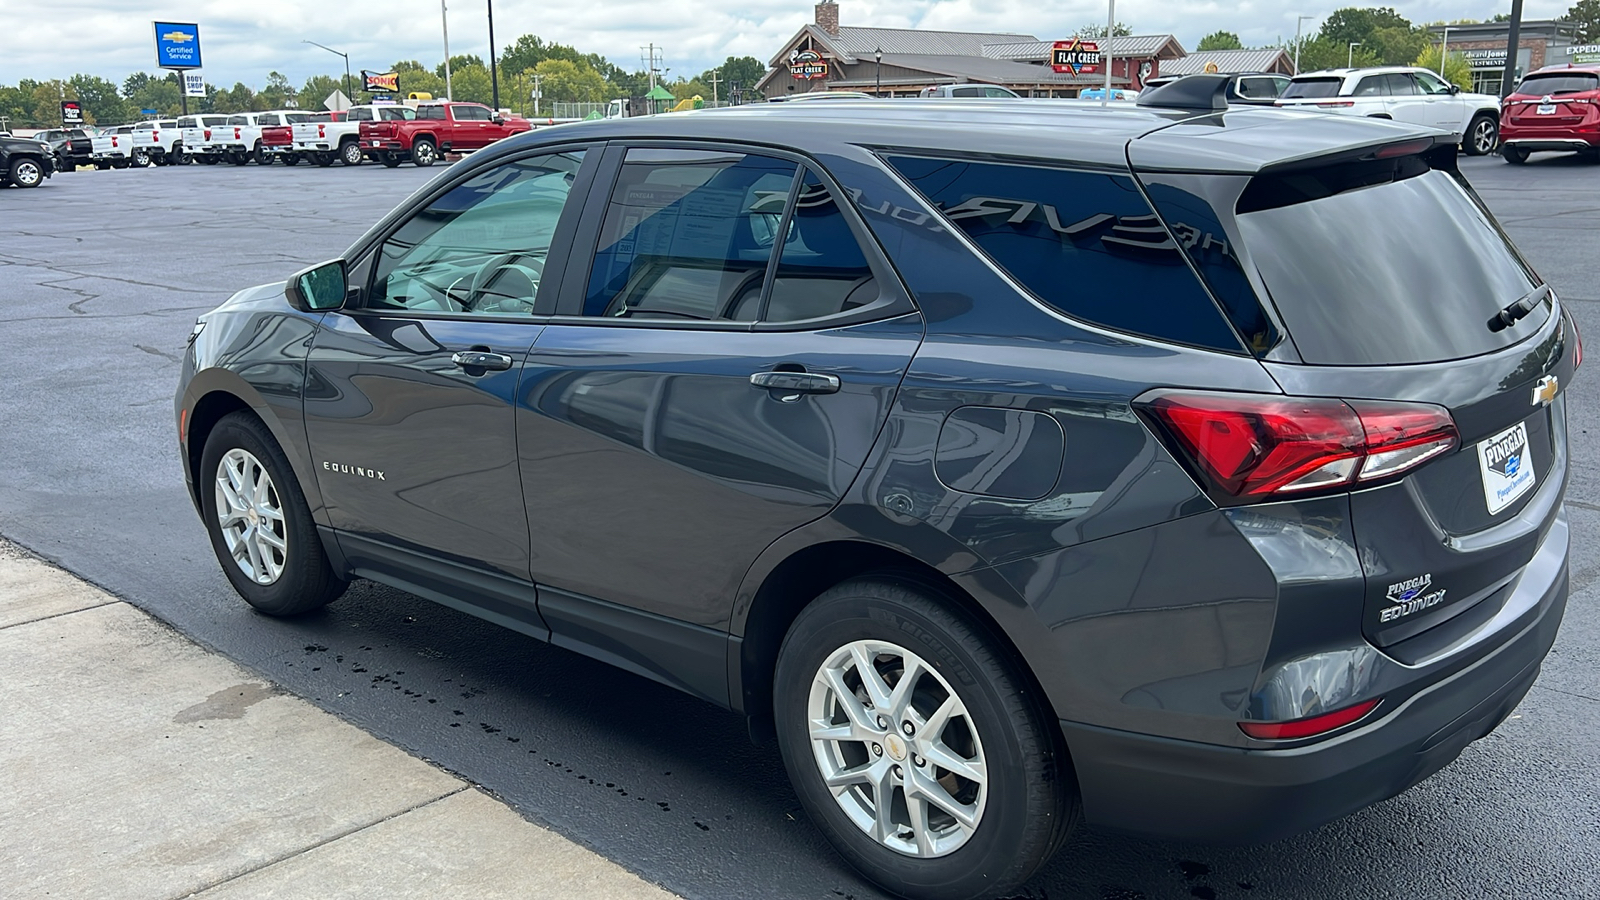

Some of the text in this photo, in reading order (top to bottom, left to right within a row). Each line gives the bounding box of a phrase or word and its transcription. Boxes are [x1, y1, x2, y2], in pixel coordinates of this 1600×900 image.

[1058, 52, 1100, 63] FLAT CREEK
[368, 76, 396, 86] SONIC
[1485, 427, 1525, 467] PINEGAR
[323, 461, 386, 481] EQUINOX
[1387, 573, 1431, 595] PINEGAR
[1380, 588, 1446, 622] EQUINOX
